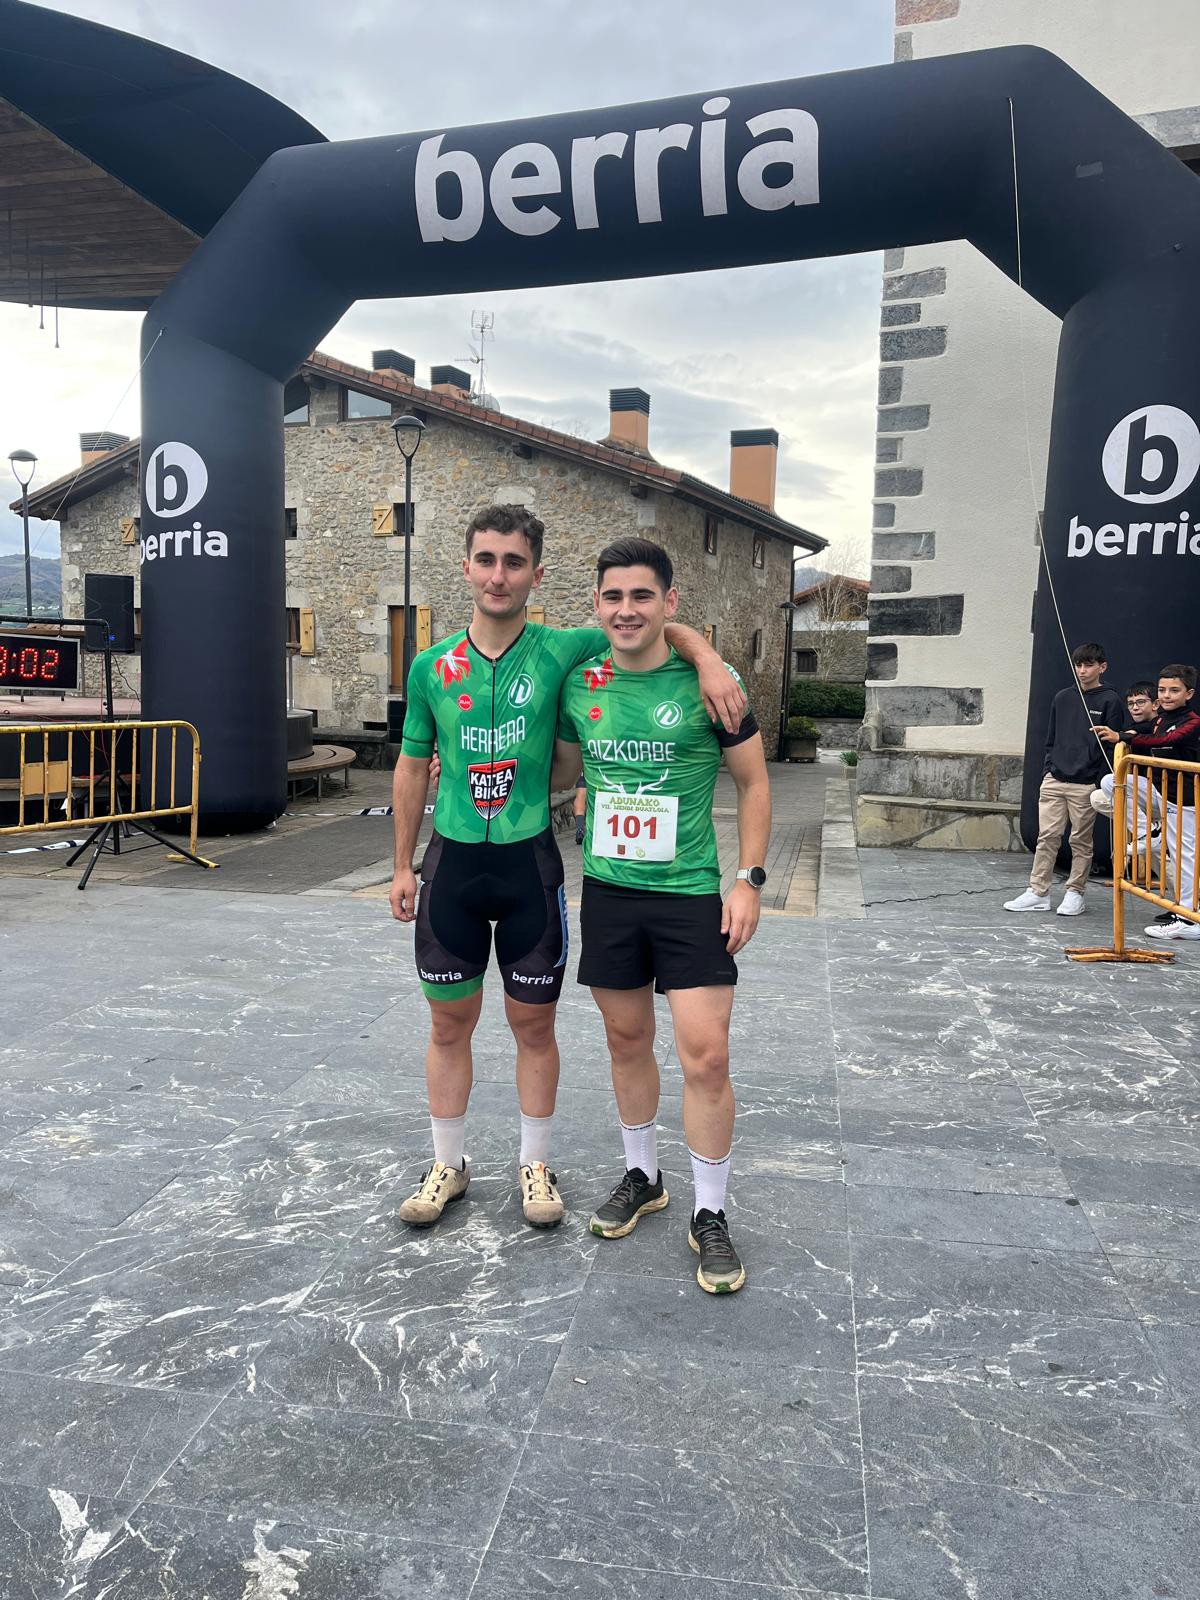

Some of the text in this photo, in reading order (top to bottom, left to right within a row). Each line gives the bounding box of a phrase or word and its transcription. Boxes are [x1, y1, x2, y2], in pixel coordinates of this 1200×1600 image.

[414, 96, 820, 243] berria
[1124, 414, 1179, 495] b
[155, 450, 188, 512] b
[140, 522, 228, 566] erria
[460, 715, 526, 753] HERRERA
[587, 739, 676, 761] AIZKORBE
[470, 768, 513, 787] KATEA
[474, 783, 508, 799] BIKE
[609, 796, 660, 807] ADUNAKO
[607, 814, 657, 839] 101
[420, 968, 462, 981] berria
[512, 972, 554, 985] berria
